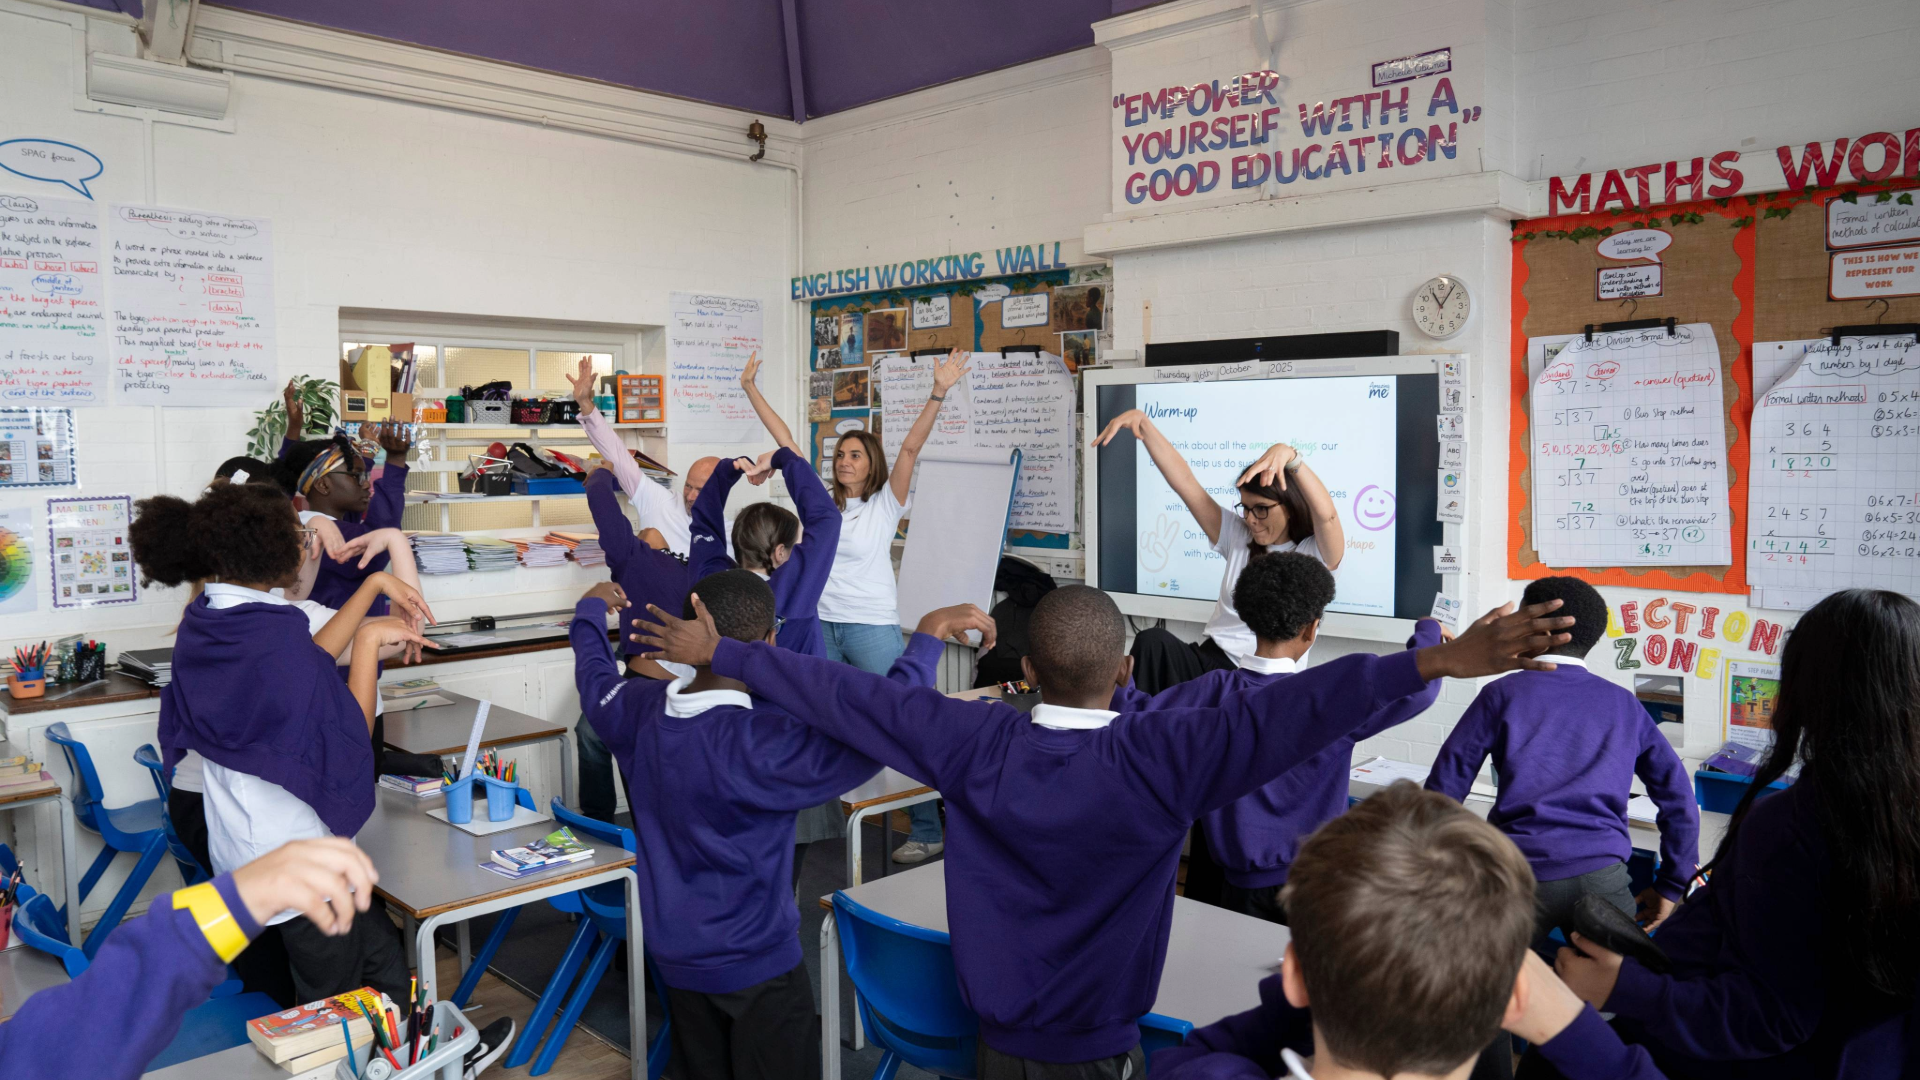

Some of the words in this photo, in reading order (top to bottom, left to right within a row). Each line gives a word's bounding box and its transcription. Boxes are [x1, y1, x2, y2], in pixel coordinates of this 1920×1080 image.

[1122, 107, 1280, 165] YOURSELF
[1298, 87, 1409, 137] WITH
[21, 148, 46, 159] SPAG
[51, 152, 76, 162] focus
[1124, 160, 1220, 205] GOOD
[1549, 150, 1744, 217] MATHS
[1836, 211, 1869, 225] Formal
[1875, 207, 1909, 219] written
[1832, 226, 1868, 239] methods
[1871, 222, 1880, 233] of
[1842, 256, 1863, 265] THIS
[1866, 255, 1875, 263] IS
[1878, 254, 1901, 262] HOW
[1903, 252, 1919, 260] WE
[791, 267, 869, 300] ENGLISH
[874, 252, 985, 290] WORKING
[996, 241, 1066, 275] WALL
[1846, 267, 1893, 277] REPRESENT
[1896, 265, 1915, 274] OUR
[1865, 280, 1893, 289] WORK
[1858, 340, 1864, 351] 3
[1866, 341, 1879, 350] and
[1894, 339, 1917, 352] digit
[1820, 360, 1855, 369] numbers
[1860, 361, 1870, 372] by
[1884, 358, 1905, 369] digit
[1156, 369, 1191, 382] Thursday
[1219, 365, 1251, 376] October
[1270, 362, 1293, 374] 2025
[1368, 387, 1389, 399] me
[1797, 393, 1822, 404] written
[1826, 391, 1864, 403] methods
[1144, 401, 1198, 422] Warm-up
[1635, 407, 1649, 419] Bus
[1169, 441, 1188, 450] hink
[1191, 441, 1217, 450] about
[1220, 441, 1230, 450] all
[1233, 441, 1246, 450] the
[1321, 442, 1338, 450] our
[1634, 439, 1649, 449] How
[1651, 441, 1669, 455] many
[1672, 438, 1689, 447] times
[1191, 459, 1209, 469] help
[1224, 459, 1236, 468] do
[1205, 486, 1237, 496] reative,
[97, 503, 124, 512] TREAT
[1165, 502, 1182, 512] with
[1629, 515, 1655, 525] What's
[1658, 515, 1669, 525] the
[1184, 530, 1197, 540] On
[1346, 538, 1375, 553] shape
[1184, 549, 1202, 558] with
[1614, 634, 1721, 679] ZONE
[1747, 702, 1757, 712] T
[1762, 700, 1771, 711] E
